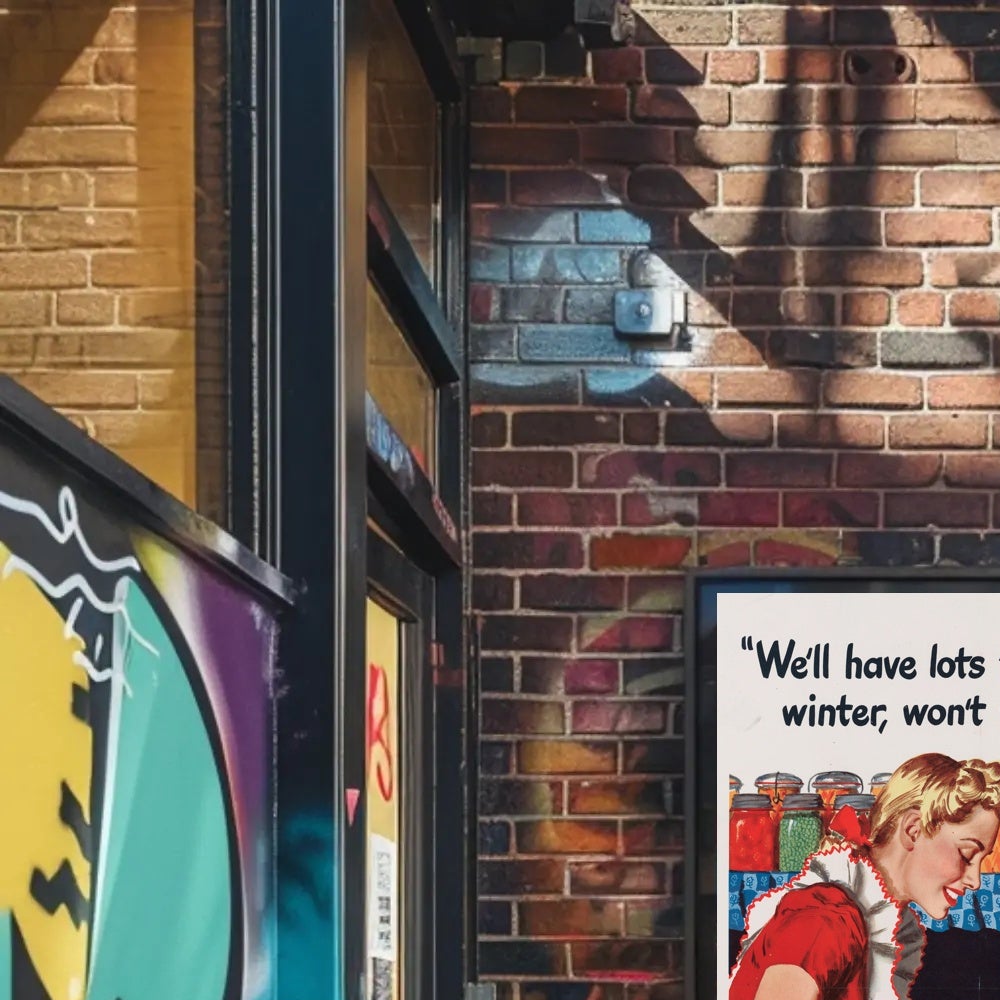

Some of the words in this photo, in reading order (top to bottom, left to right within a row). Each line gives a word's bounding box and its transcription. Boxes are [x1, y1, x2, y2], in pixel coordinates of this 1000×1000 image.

[741, 635, 830, 680] "We'll
[845, 642, 918, 681] have
[929, 643, 986, 680] lots
[781, 693, 888, 735] winter,
[902, 695, 987, 727] won't
